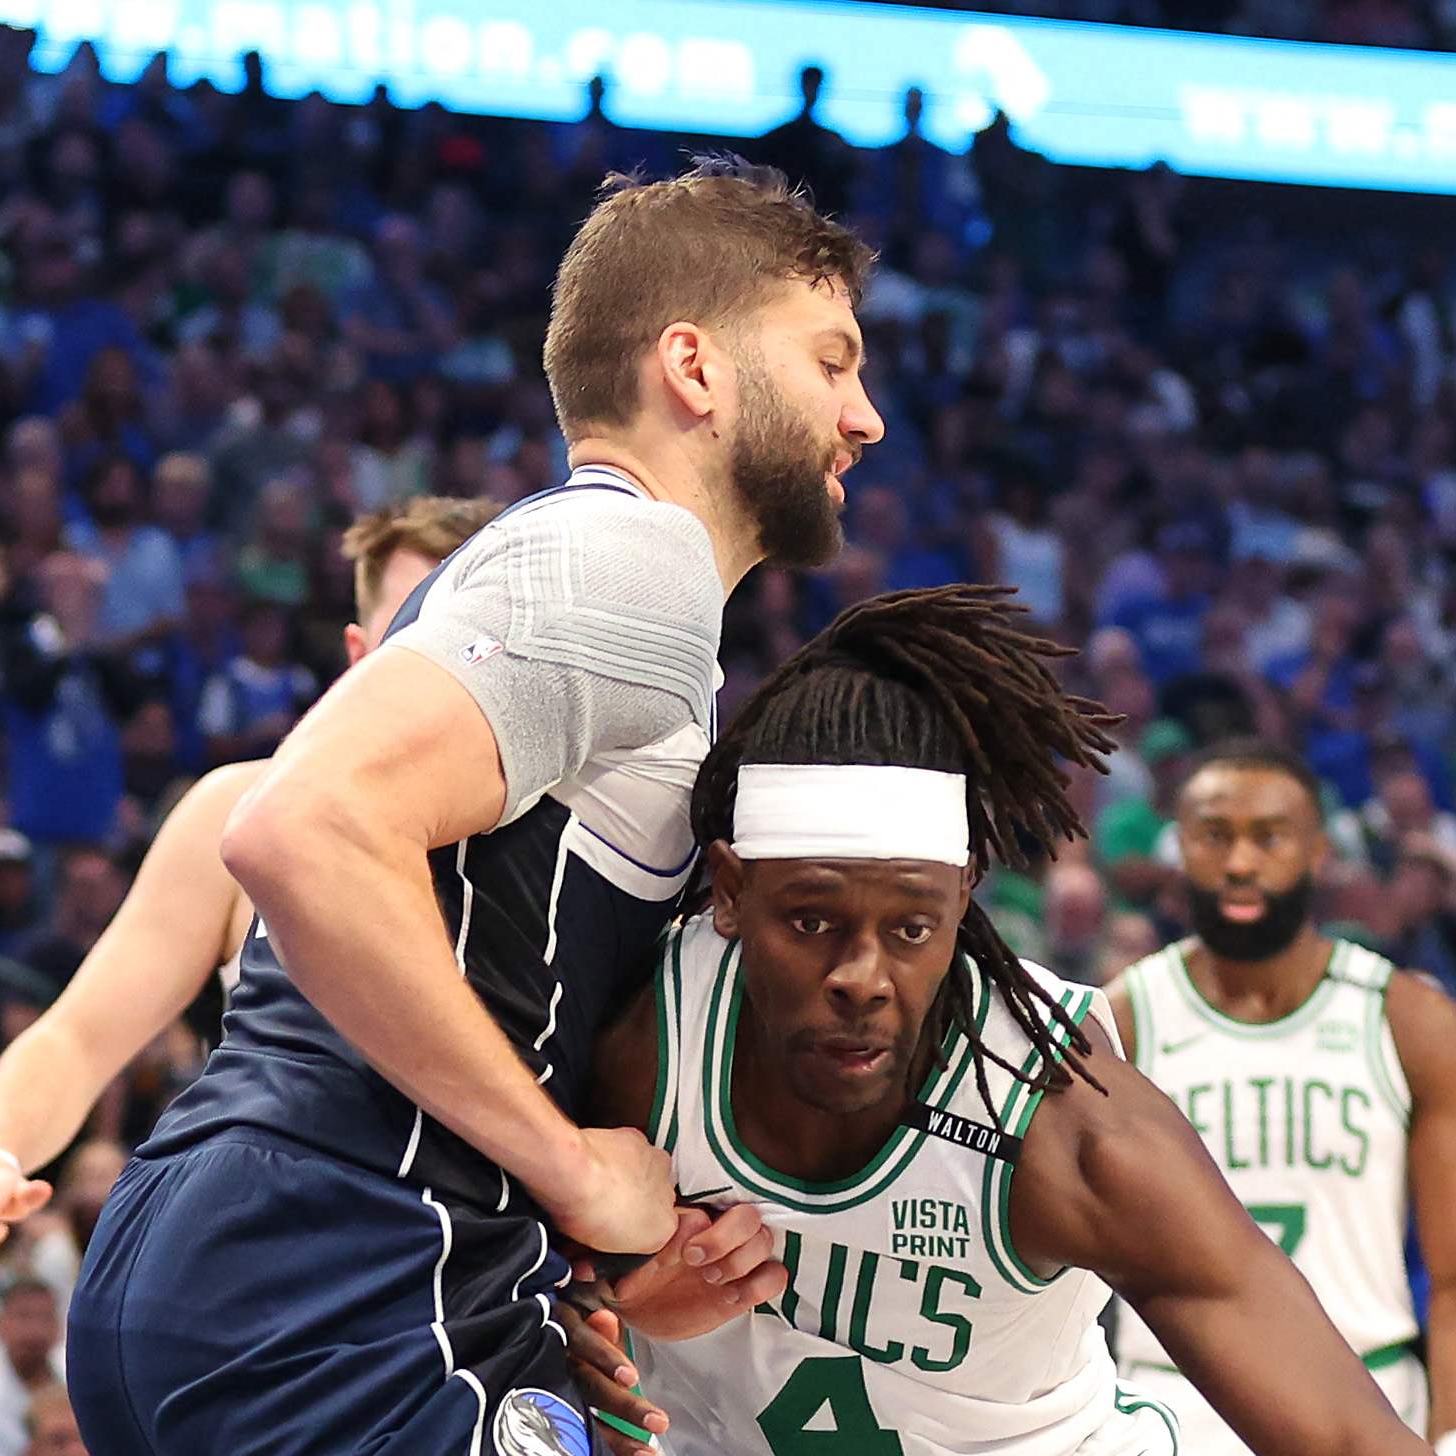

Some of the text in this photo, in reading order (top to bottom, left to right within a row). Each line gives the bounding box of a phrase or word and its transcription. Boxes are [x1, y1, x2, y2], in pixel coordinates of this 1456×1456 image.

[927, 1110, 1001, 1153] WALTON
[1172, 1076, 1372, 1177] ELTICS
[892, 1199, 969, 1236] VISTA
[892, 1233, 970, 1258] PRINT
